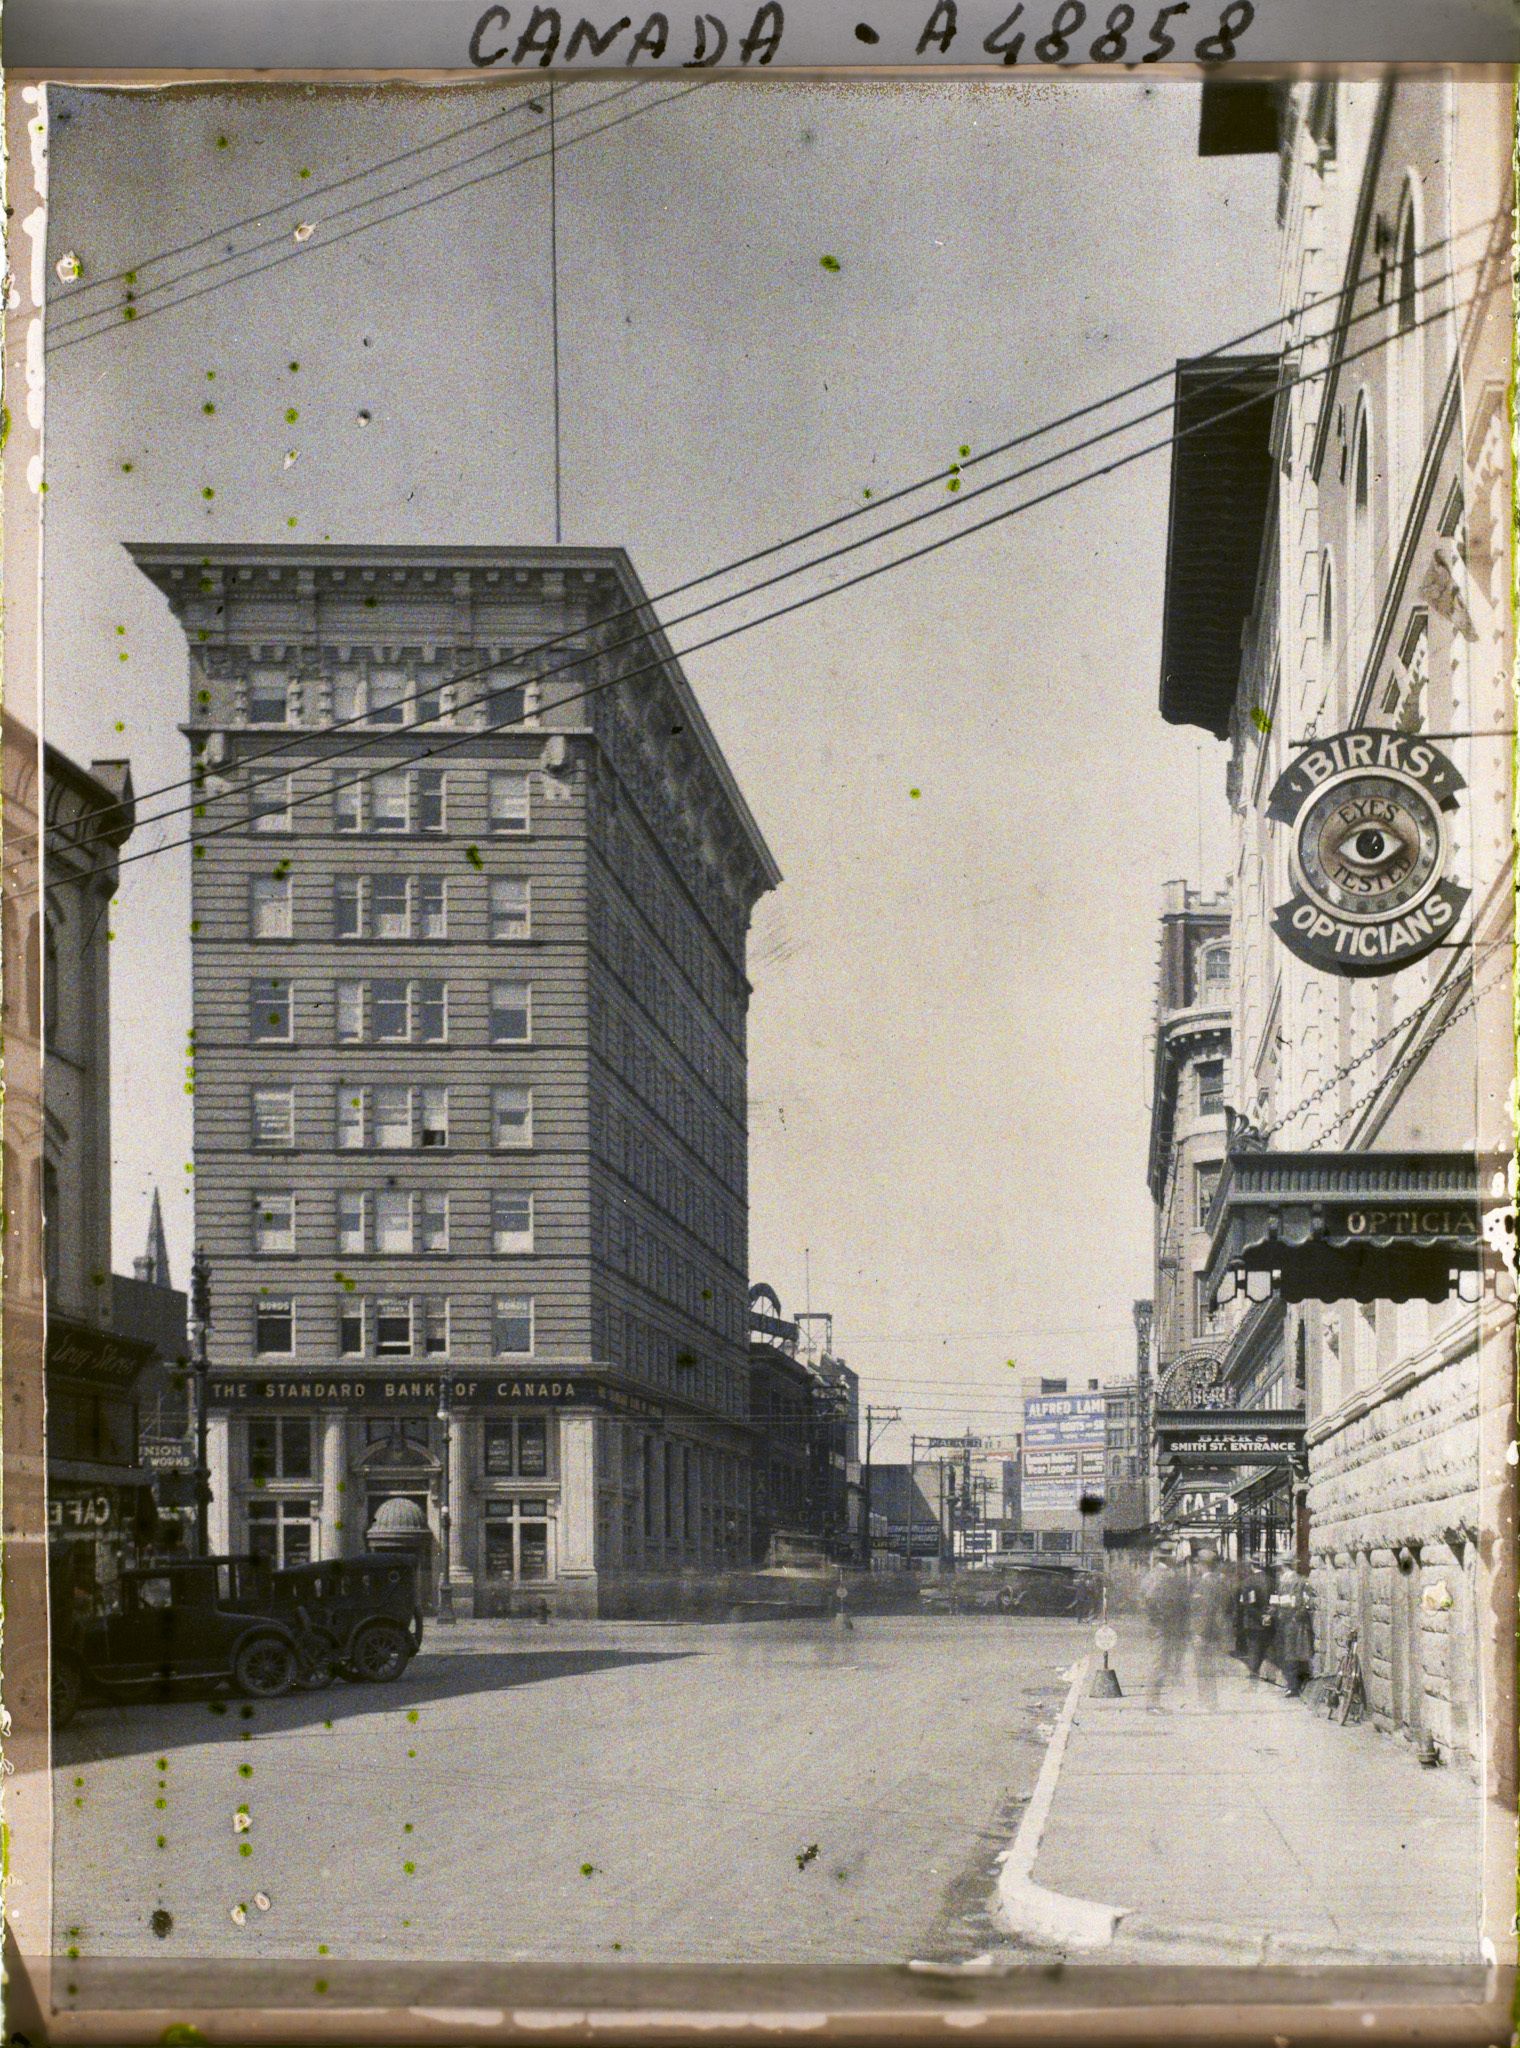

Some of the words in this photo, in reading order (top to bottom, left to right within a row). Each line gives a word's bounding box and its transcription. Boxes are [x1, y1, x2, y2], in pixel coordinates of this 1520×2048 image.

[1299, 733, 1435, 785] BIRKS
[1339, 800, 1399, 824] EYES
[1333, 859, 1411, 892] TESTED
[1292, 895, 1452, 957] OPTICIANS
[213, 1384, 247, 1398] THE
[265, 1384, 366, 1398] STANDARD
[385, 1384, 434, 1397] BANK
[456, 1384, 478, 1397] OF
[499, 1384, 576, 1397] CANADA
[1029, 1401, 1072, 1417] ALFRED
[930, 1439, 981, 1448] WALKER
[1170, 1442, 1206, 1451] SMITH
[1209, 1442, 1228, 1451] ST.
[1230, 1442, 1296, 1451] ENTRANCE
